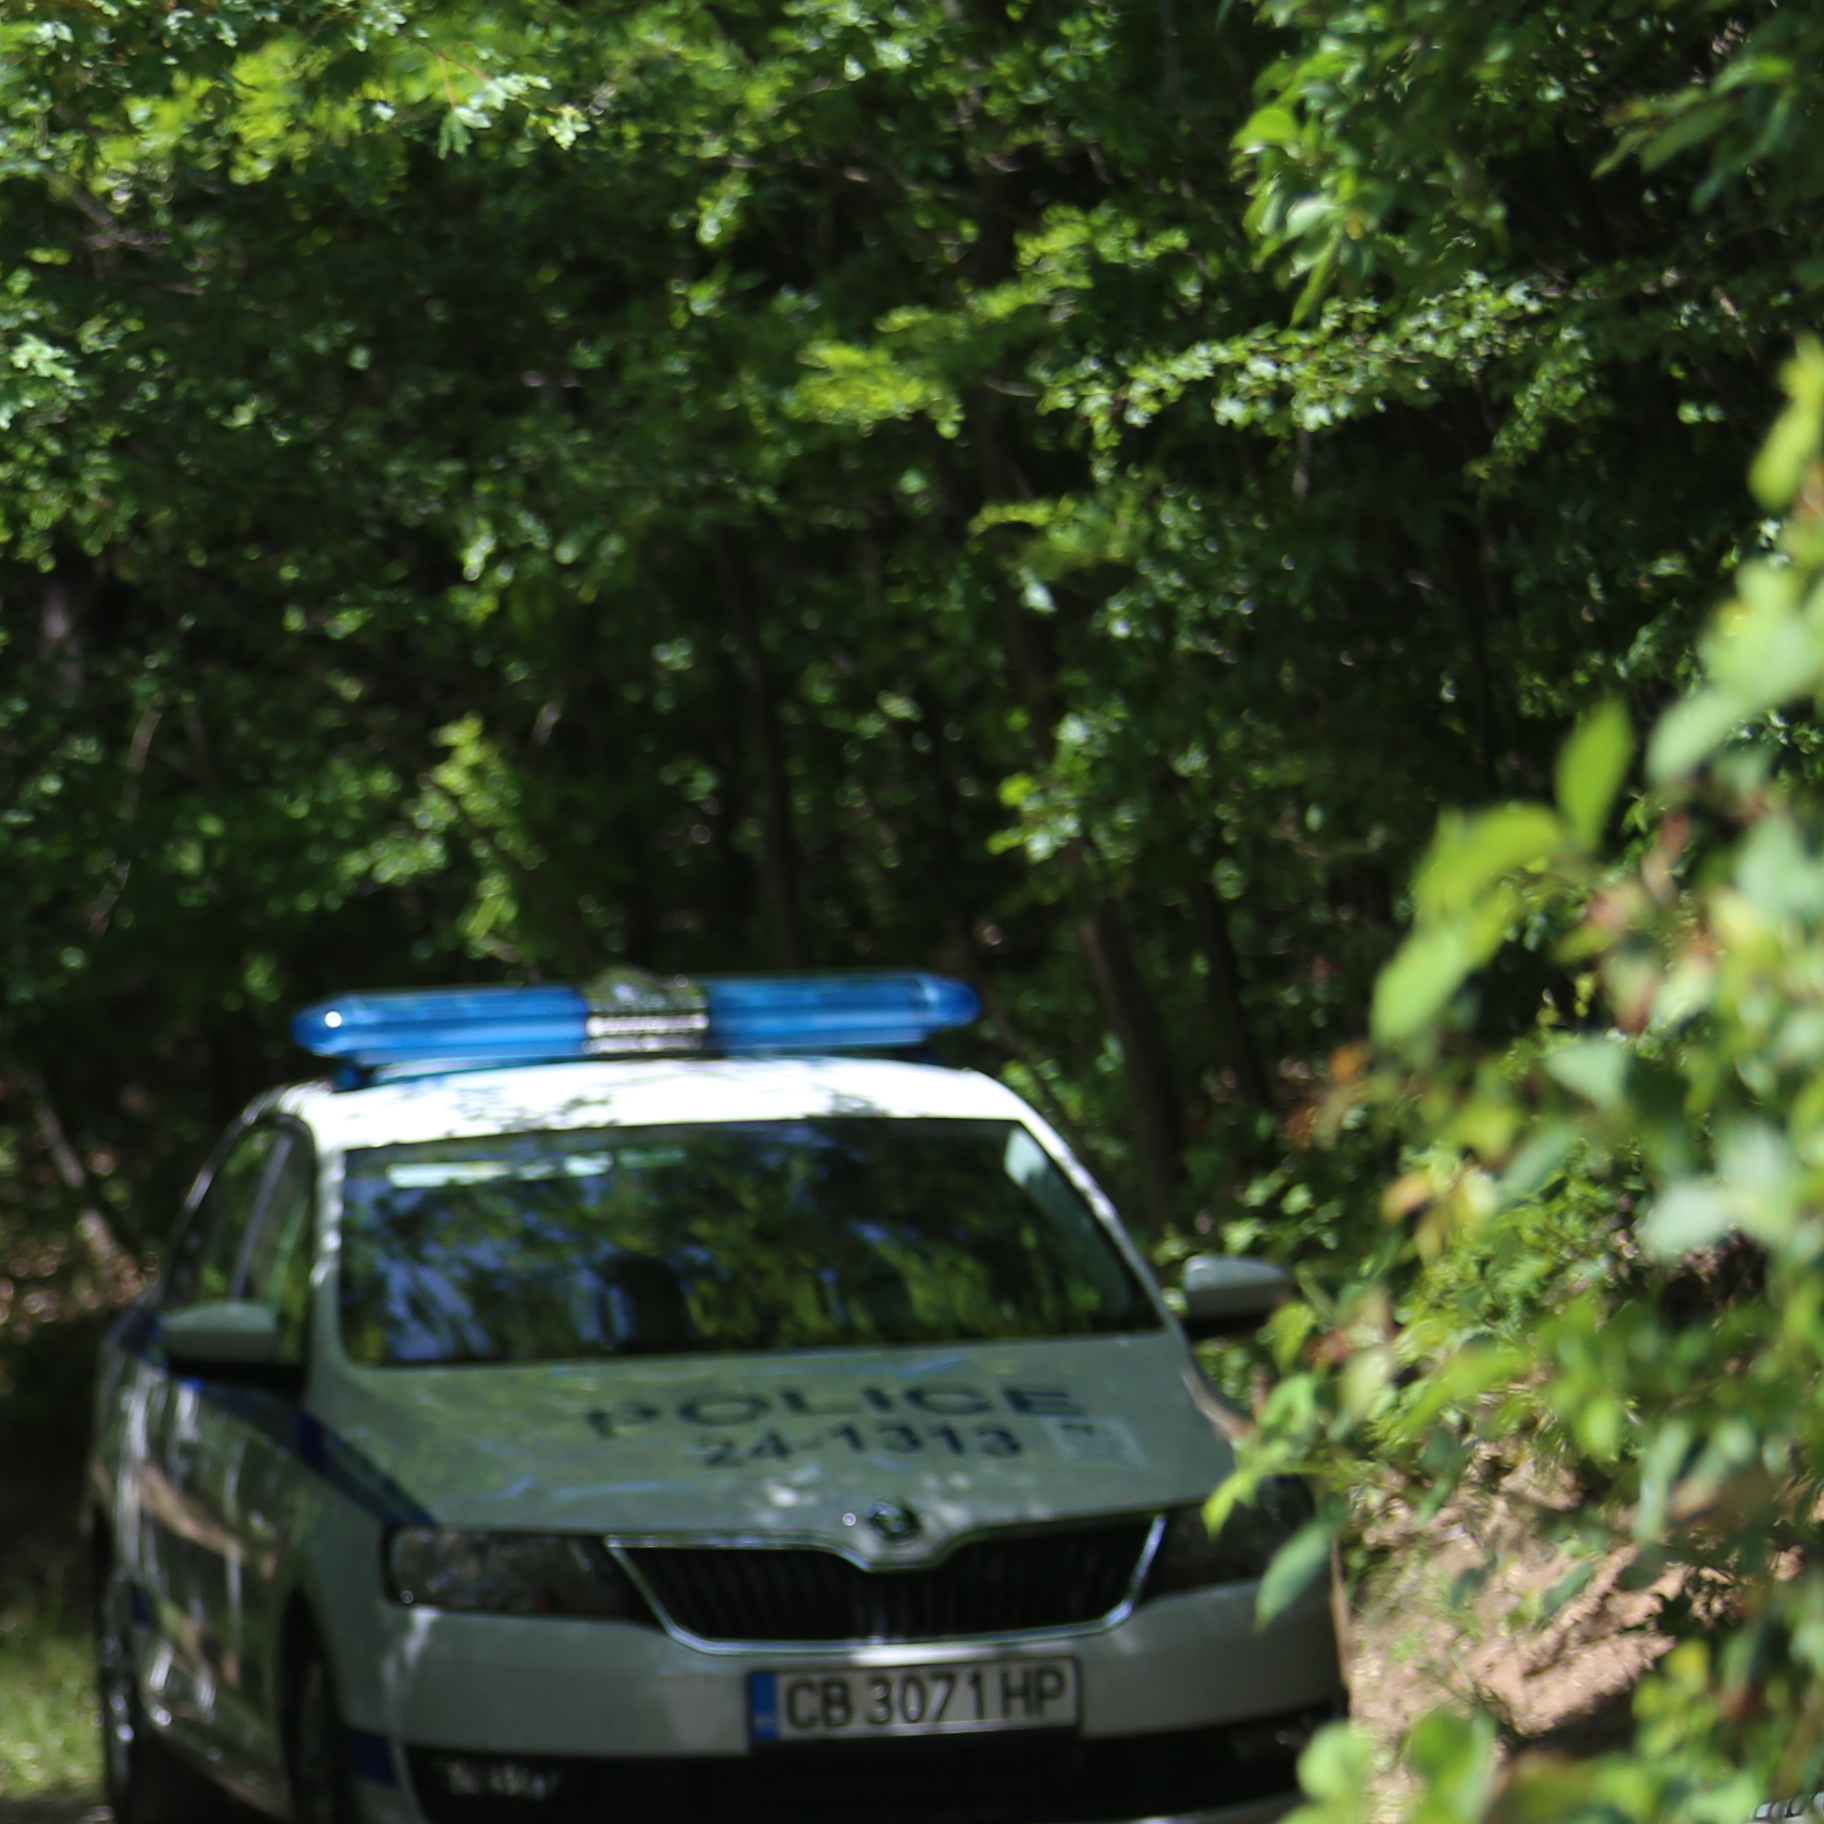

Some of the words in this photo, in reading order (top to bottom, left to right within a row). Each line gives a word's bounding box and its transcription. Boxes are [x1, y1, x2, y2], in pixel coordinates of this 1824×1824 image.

[696, 1421, 1025, 1470] 24-1313
[786, 1673, 852, 1729] CB
[866, 1668, 985, 1725] 3071
[1001, 1663, 1067, 1718] HP
